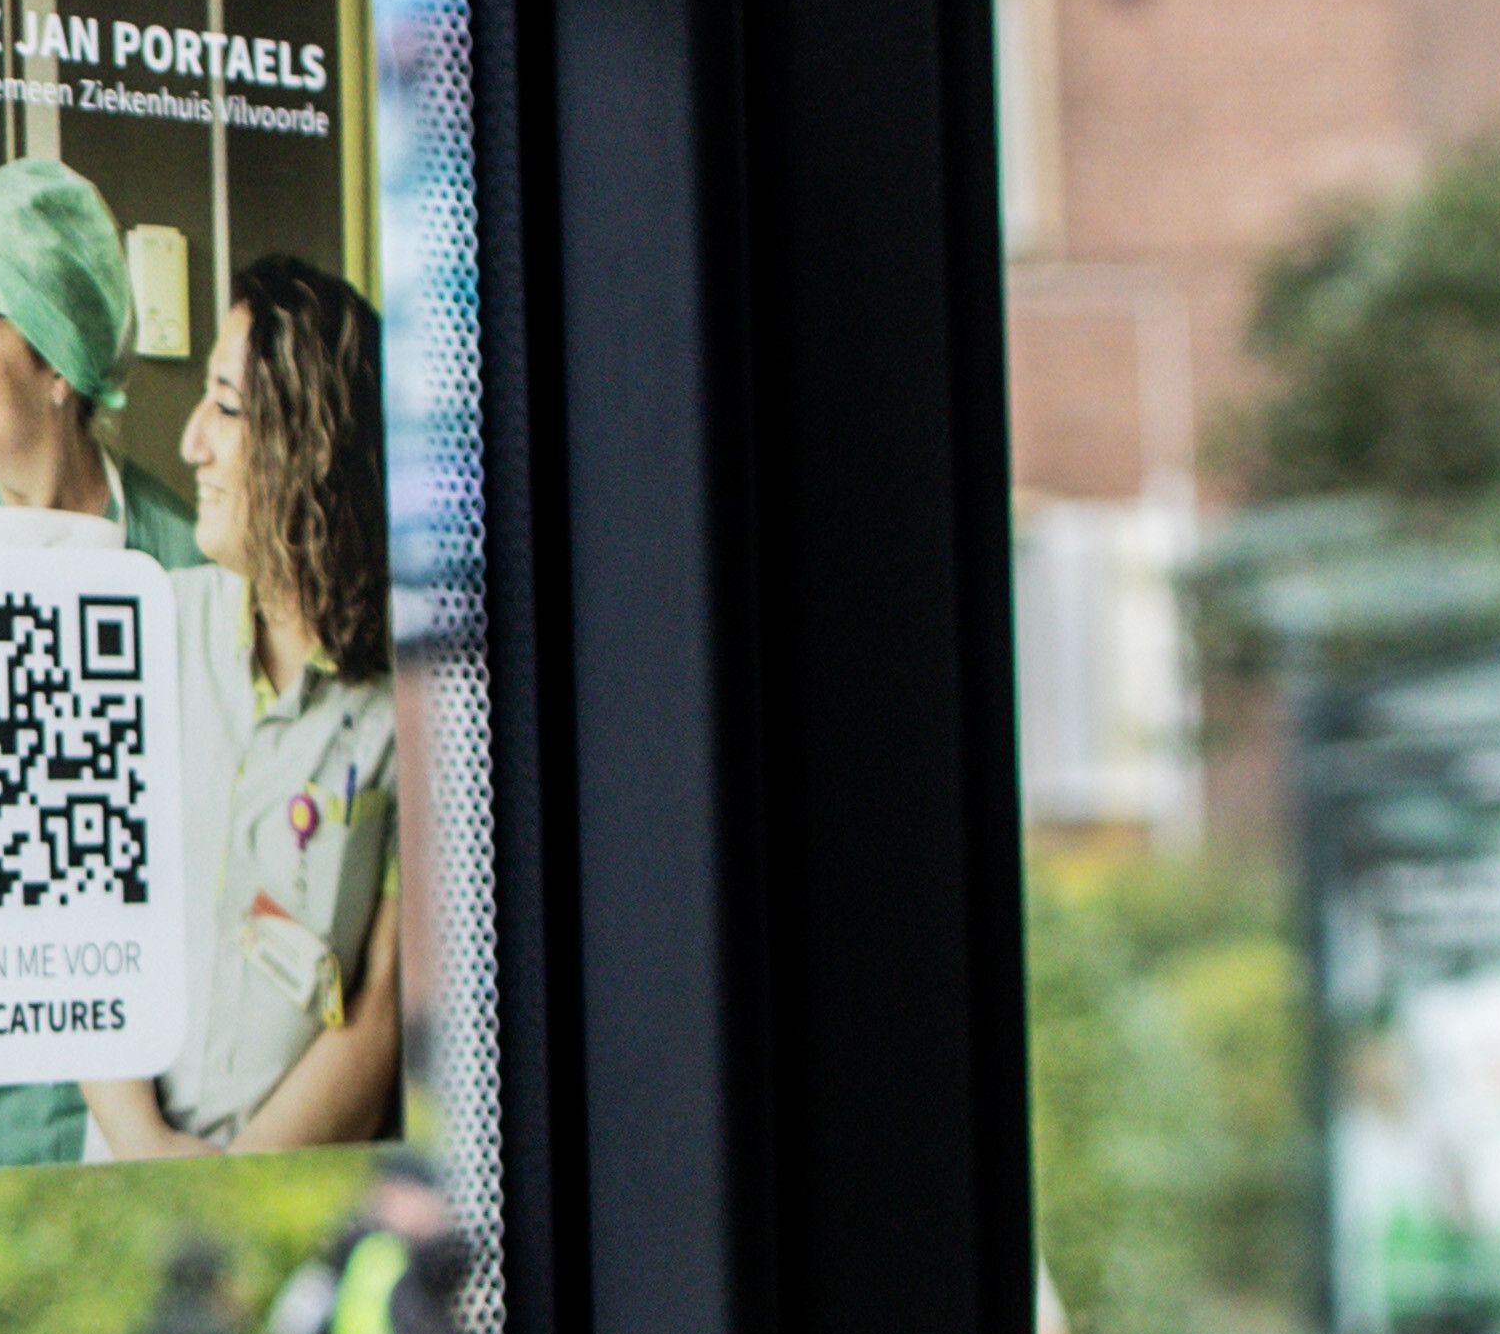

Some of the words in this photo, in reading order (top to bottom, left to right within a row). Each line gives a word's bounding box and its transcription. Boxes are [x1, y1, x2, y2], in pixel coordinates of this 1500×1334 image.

[15, 9, 100, 65] JAN
[111, 20, 328, 92] PORTAELS
[78, 78, 213, 124] Ziekenhuis
[212, 93, 330, 137] Vilvoorde
[17, 943, 57, 978] ME
[63, 940, 142, 977] VOOR
